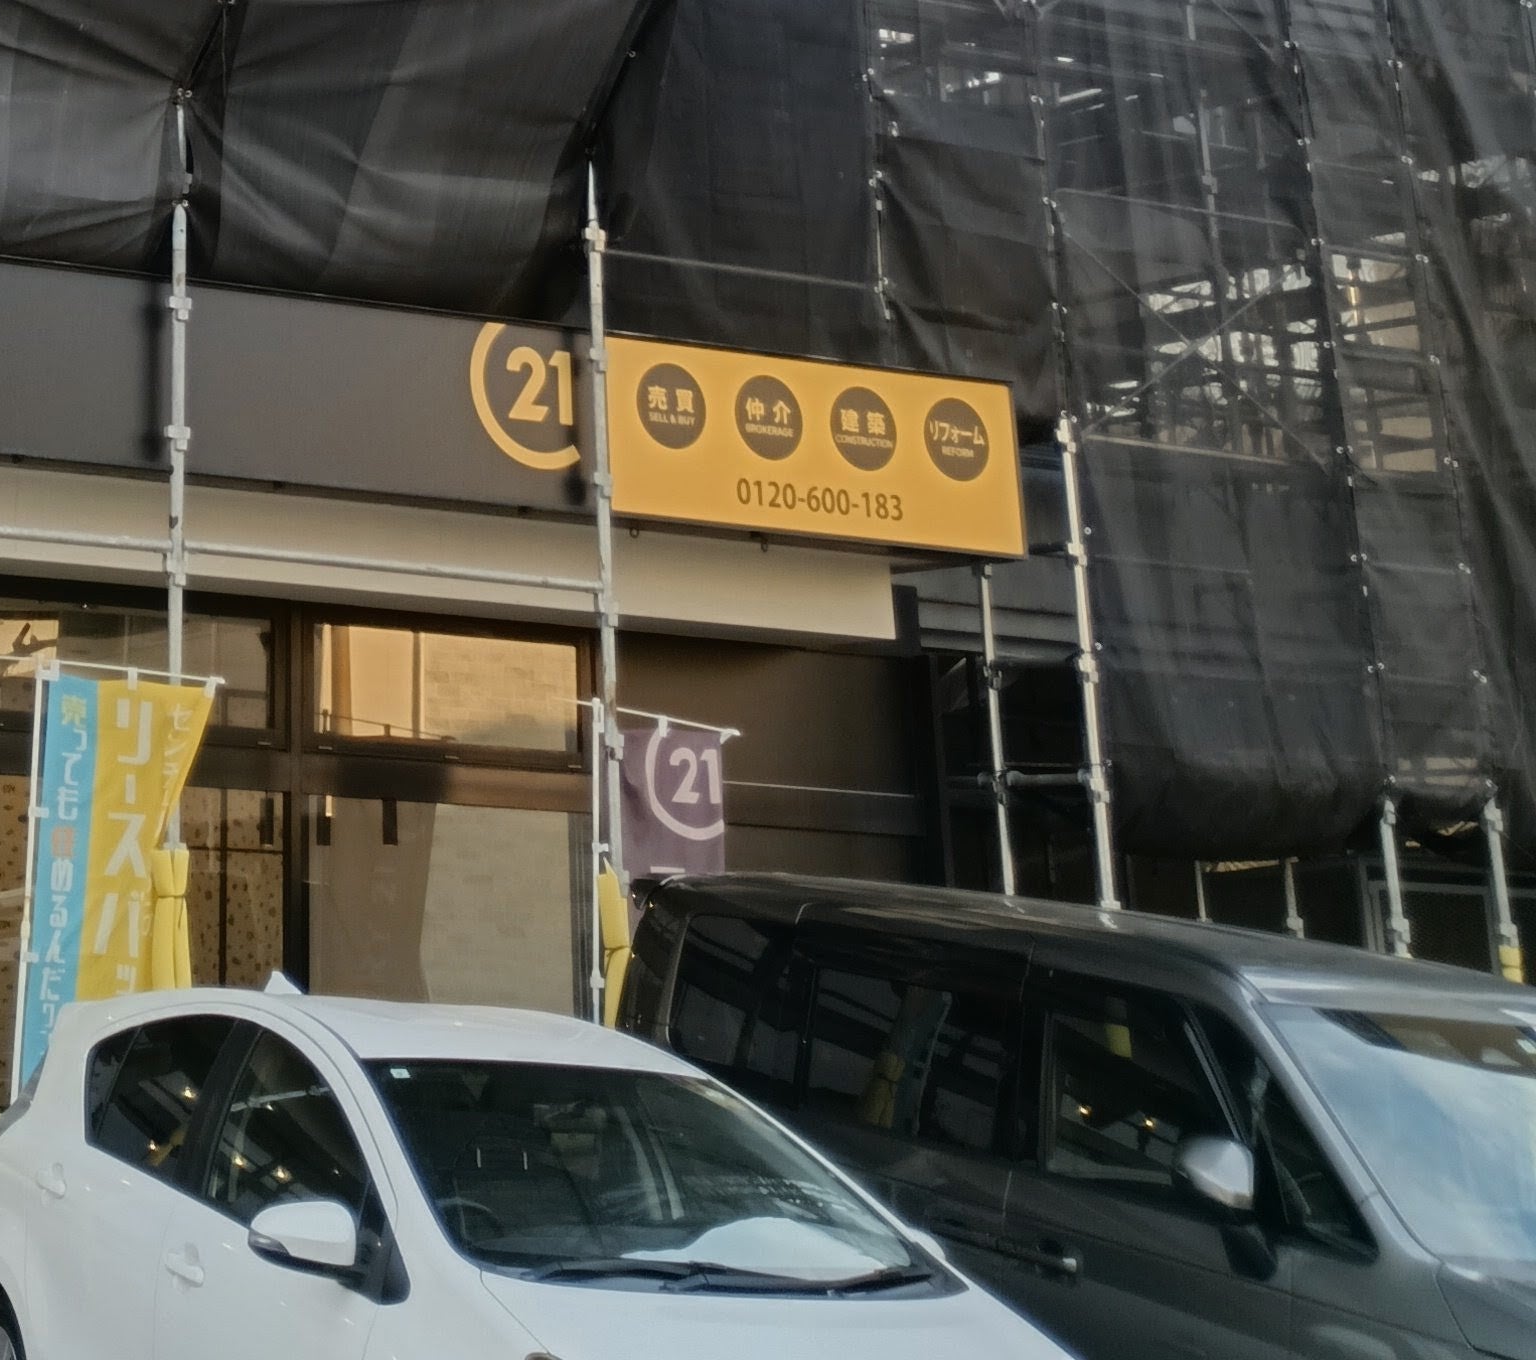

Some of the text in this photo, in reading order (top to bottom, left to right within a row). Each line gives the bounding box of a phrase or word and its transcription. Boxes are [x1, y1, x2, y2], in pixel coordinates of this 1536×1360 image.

[647, 385, 695, 414] 売買
[745, 397, 792, 425] 仲介
[649, 411, 669, 425] SELL
[678, 414, 696, 427] BUY
[745, 423, 794, 438] BROKERAGE
[840, 408, 886, 436] 建築
[834, 434, 894, 449] CONSTRUCTION
[929, 420, 986, 446] リフォーム
[941, 445, 975, 458] REFORM
[736, 477, 904, 522] 0120-600-183
